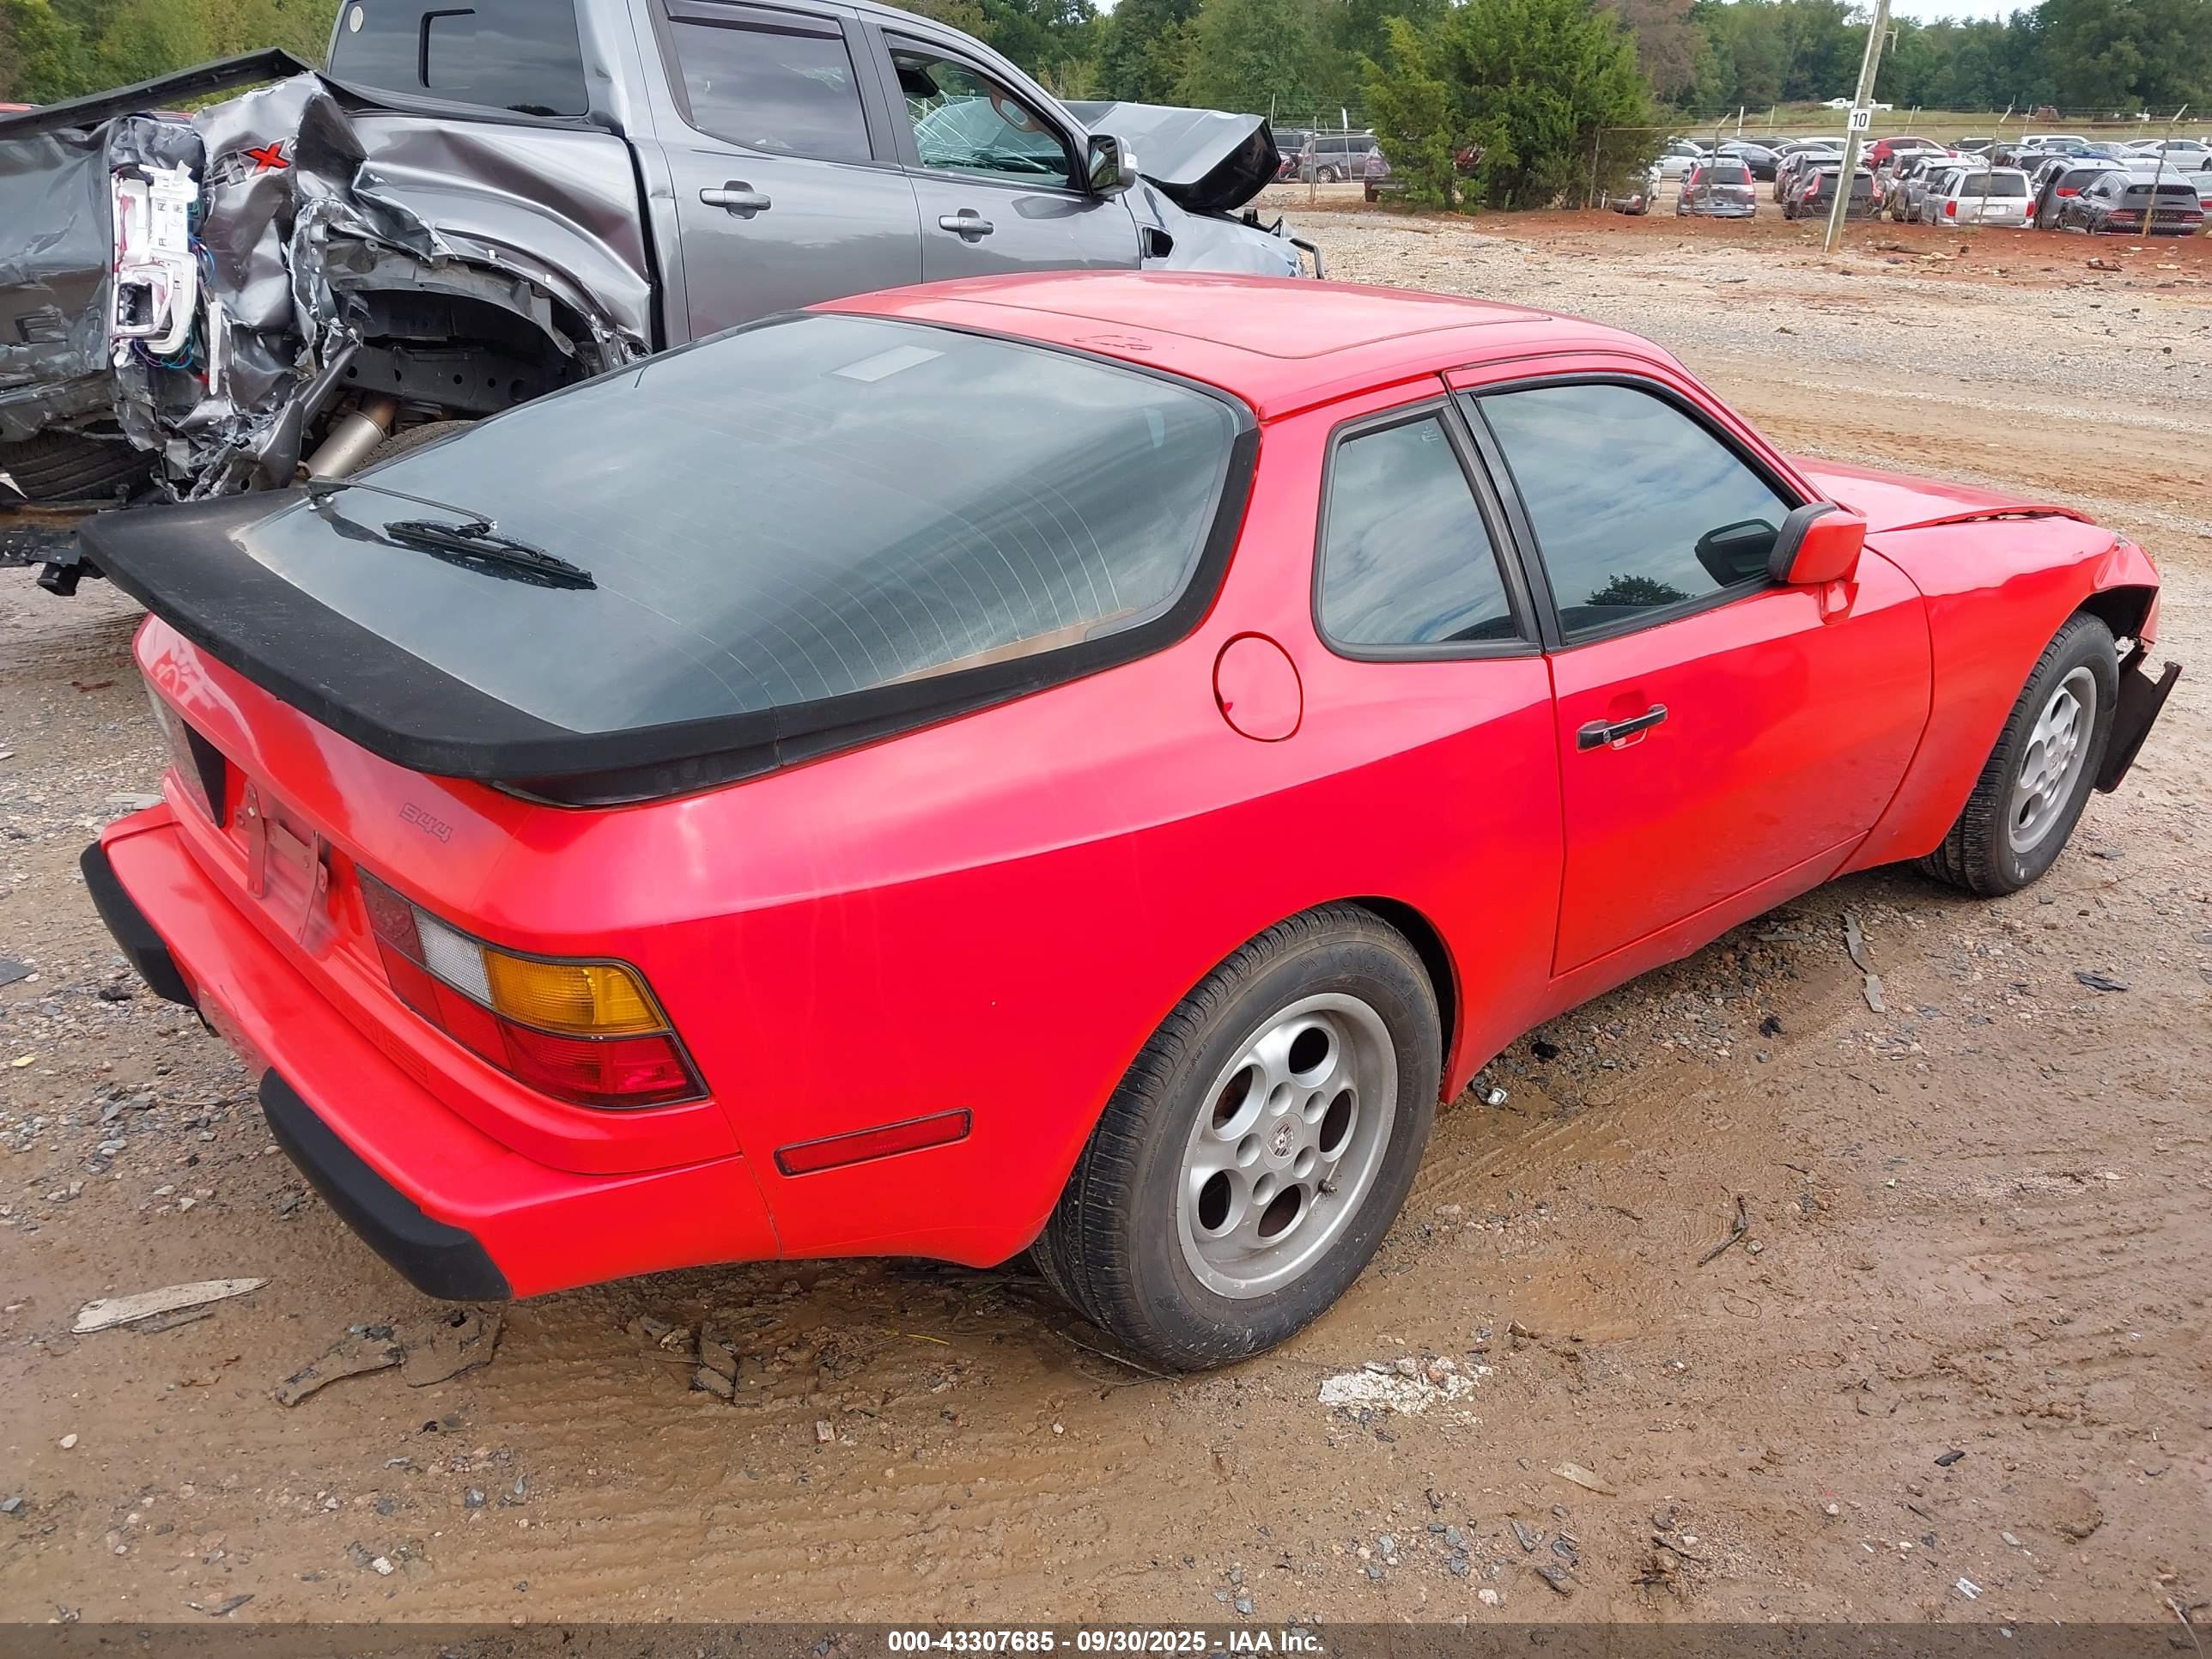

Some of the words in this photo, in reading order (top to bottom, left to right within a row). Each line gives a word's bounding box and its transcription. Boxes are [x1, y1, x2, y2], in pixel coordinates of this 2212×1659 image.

[1852, 112, 1868, 127] 10
[398, 802, 453, 843] 944
[1328, 947, 1418, 1007] YOKOHAMA
